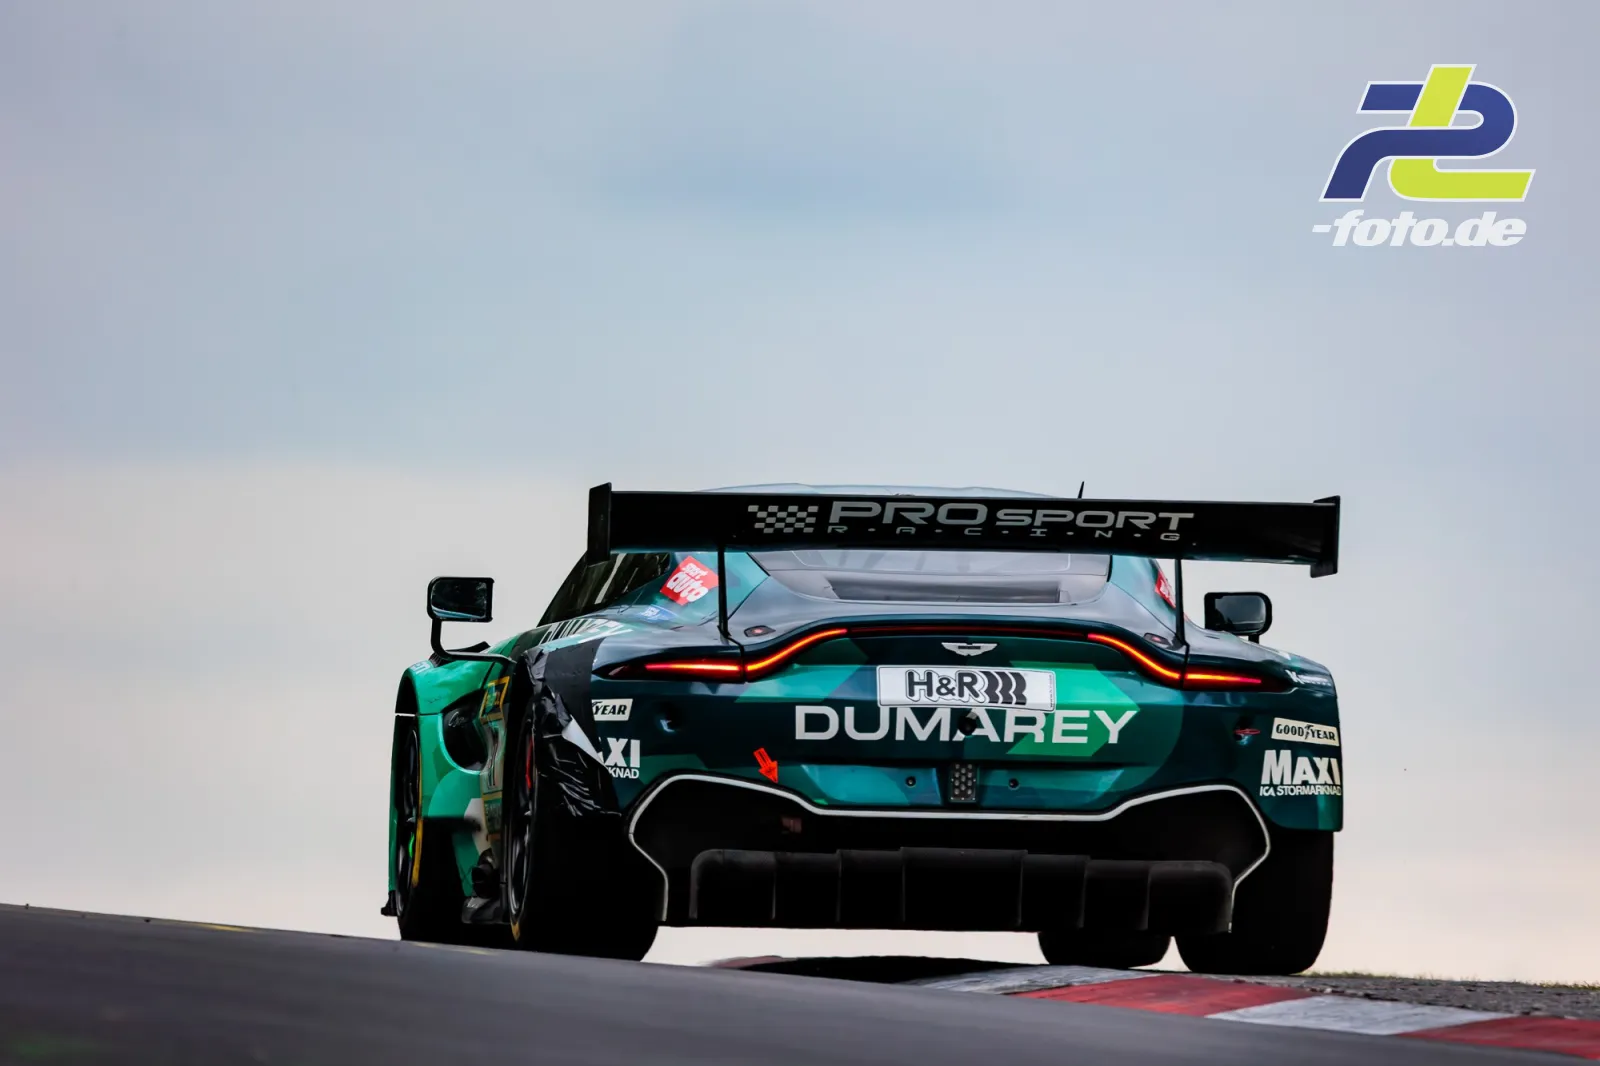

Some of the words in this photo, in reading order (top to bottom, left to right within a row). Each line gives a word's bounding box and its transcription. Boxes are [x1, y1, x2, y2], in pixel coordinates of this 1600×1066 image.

[828, 501, 988, 525] PRO
[996, 508, 1195, 531] SPORT
[666, 571, 709, 603] auto
[905, 670, 983, 701] H&R
[592, 704, 628, 716] YEAR
[795, 704, 1137, 744] DUMAREY
[607, 766, 640, 780] KNAD
[1260, 749, 1342, 786] MAXI
